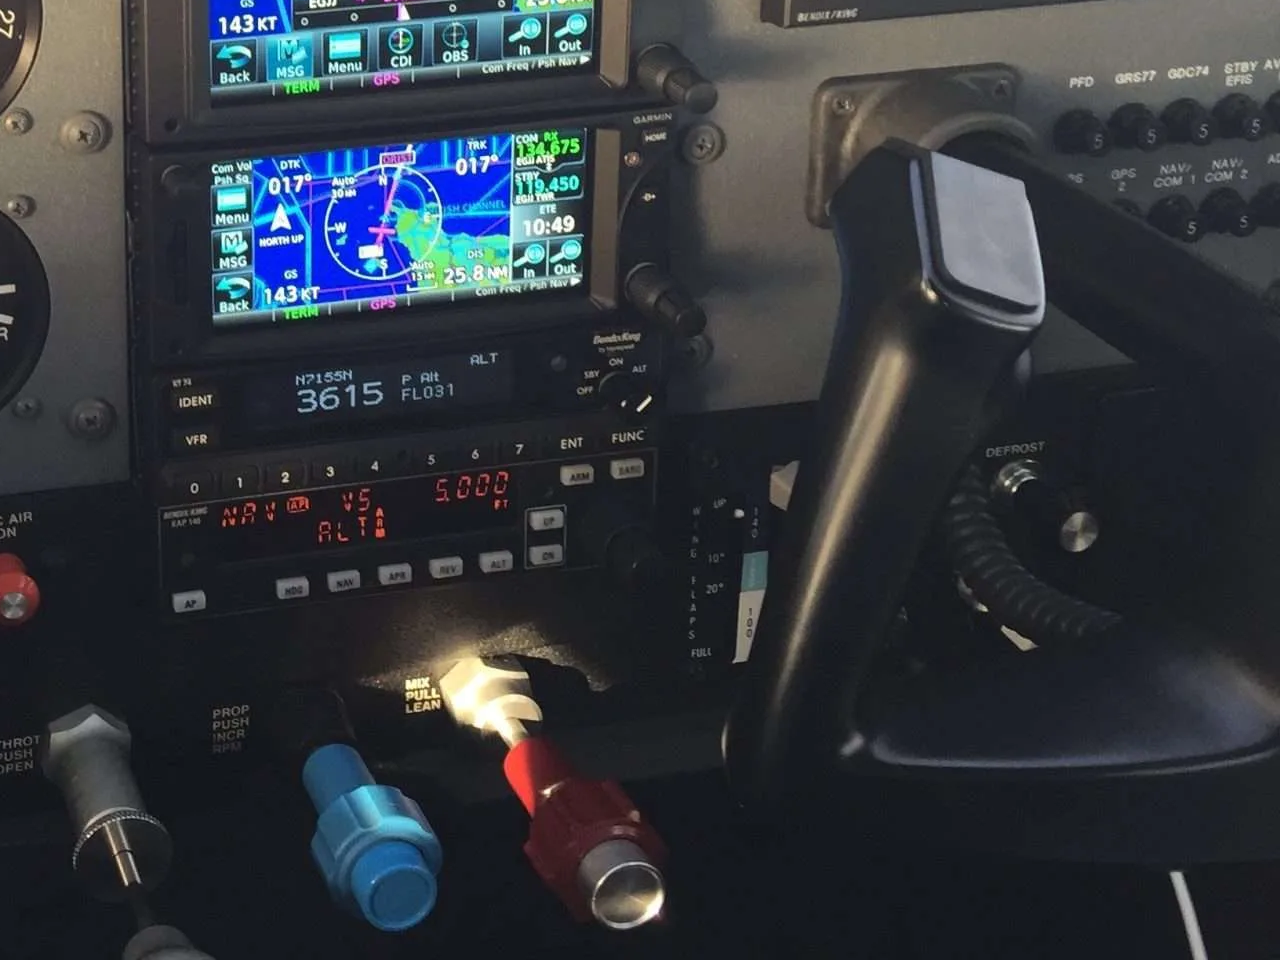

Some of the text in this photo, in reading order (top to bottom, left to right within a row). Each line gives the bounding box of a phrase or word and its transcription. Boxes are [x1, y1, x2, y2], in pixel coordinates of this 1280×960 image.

[559, 38, 582, 52] Out
[390, 54, 412, 67] CDI
[443, 49, 469, 62] OBS
[276, 65, 305, 79] MSG
[328, 60, 363, 74] Menu
[1168, 65, 1209, 80] GDC74
[220, 69, 250, 84] Back
[374, 73, 400, 87] GPS
[1070, 76, 1095, 89] PFD
[1114, 70, 1157, 85] GRS77
[1225, 74, 1253, 87] EFIS
[284, 80, 319, 95] TERM
[215, 211, 250, 225] Menu
[522, 215, 575, 237] 10:49
[219, 255, 247, 268] MSG
[219, 298, 250, 313] Back
[470, 352, 498, 366] ALT
[295, 370, 352, 385] N7155N
[297, 381, 384, 414] 3615
[402, 383, 455, 401] FL031
[179, 395, 213, 408] IDENT
[185, 434, 208, 446] VFR
[560, 438, 584, 449] ENT
[611, 430, 645, 444] FUNC
[985, 440, 1046, 459] DEFROST
[9, 512, 33, 525] AIR
[691, 647, 712, 658] FULL
[405, 678, 431, 690] MIX
[405, 688, 440, 702] PULL
[212, 705, 250, 719] PROP
[405, 698, 441, 714] LEAN
[212, 716, 250, 731] PUSH
[212, 729, 246, 743] INCR
